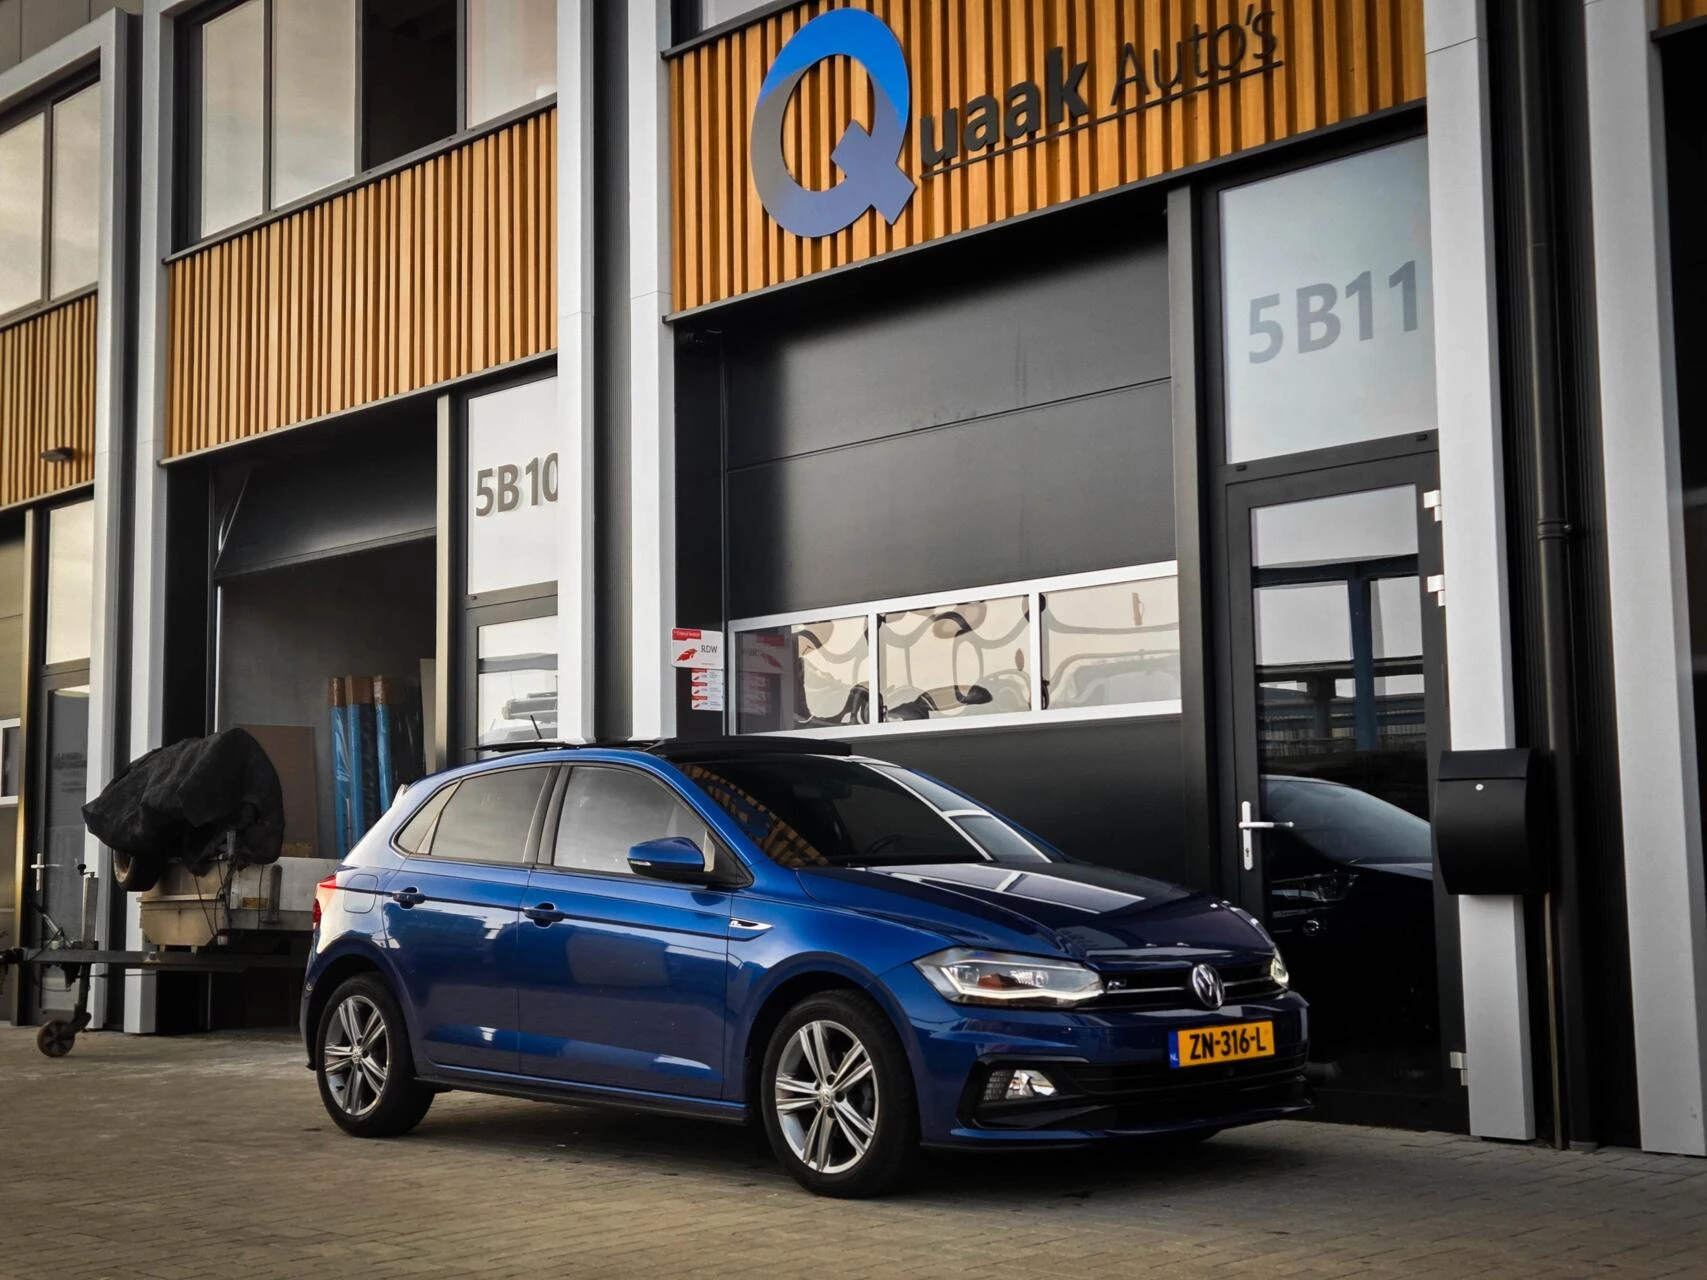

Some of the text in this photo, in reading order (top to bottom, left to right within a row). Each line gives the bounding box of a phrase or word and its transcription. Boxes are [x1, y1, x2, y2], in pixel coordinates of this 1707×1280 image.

[1110, 4, 1276, 105] Auto's
[1248, 260, 1418, 364] 5B11
[475, 452, 559, 517] 5B10
[701, 644, 718, 653] RDW
[1189, 1027, 1267, 1060] ZN-316-L
